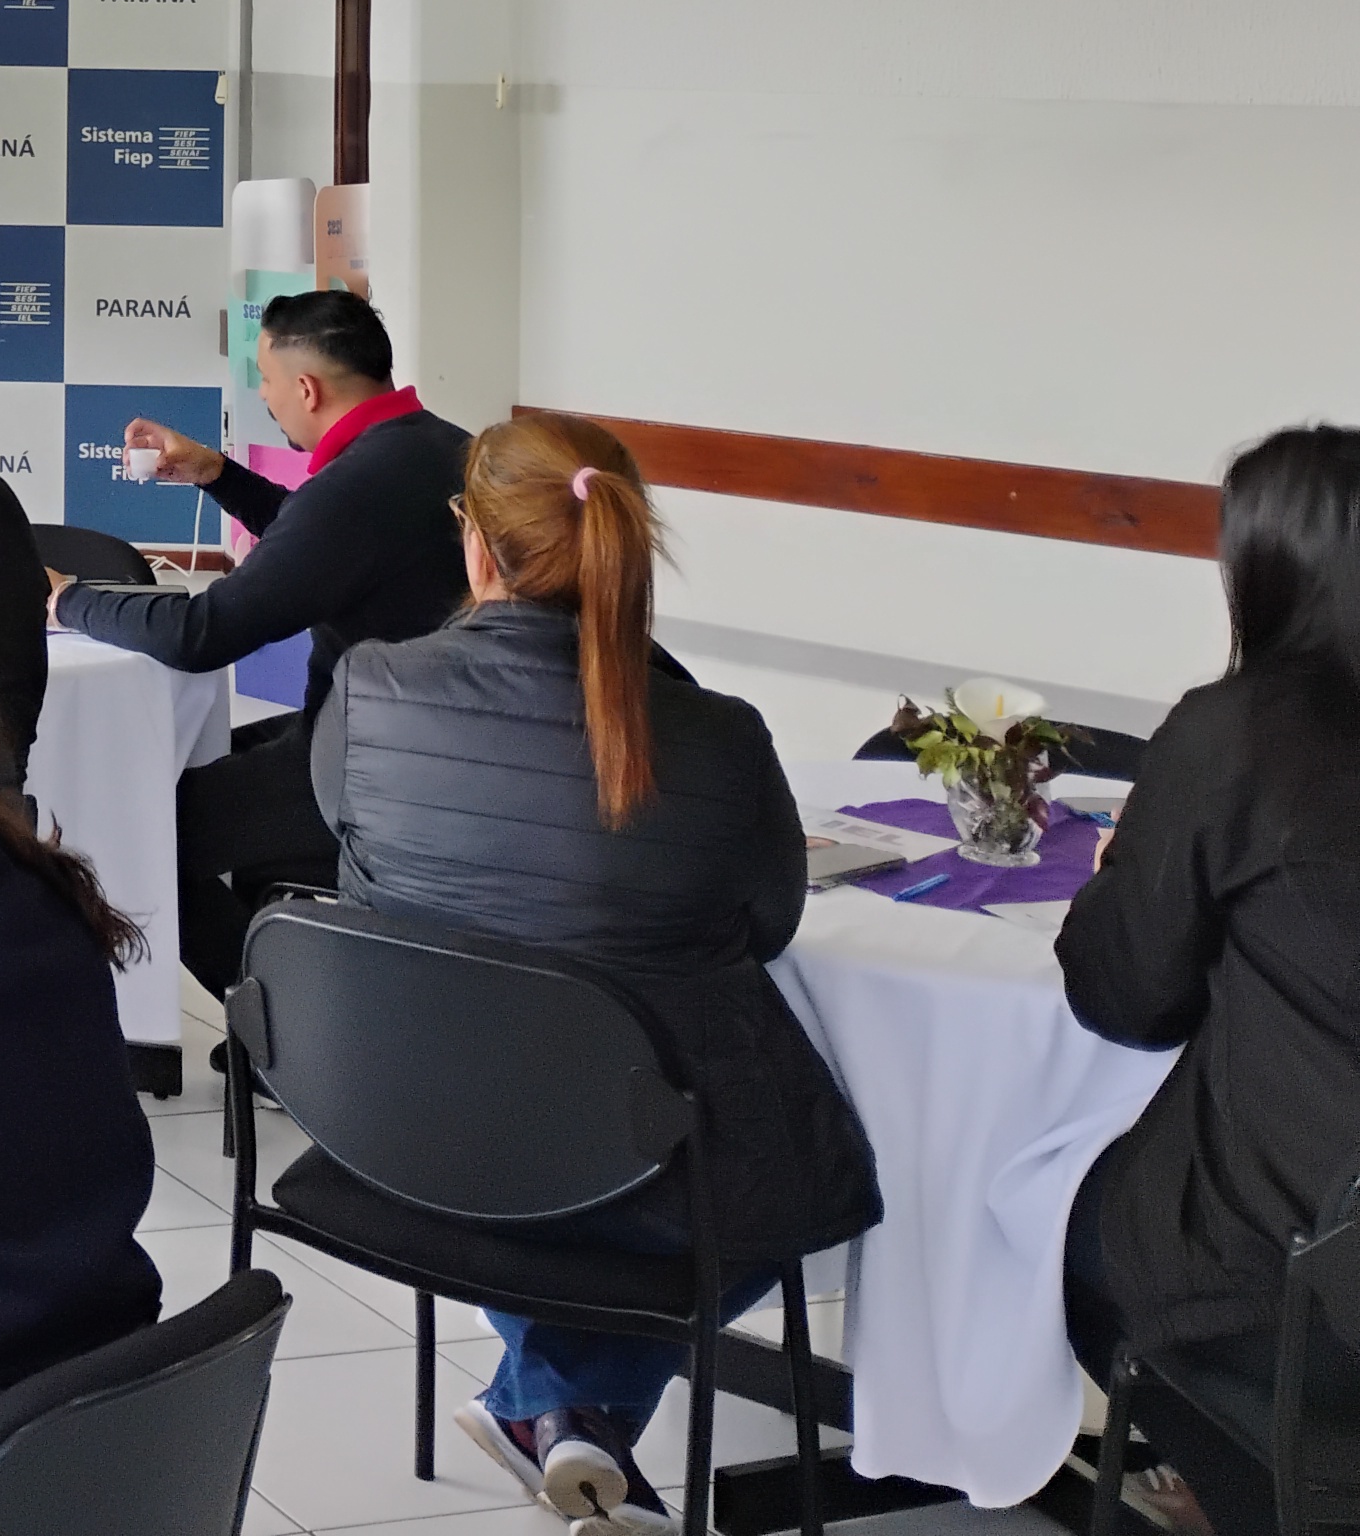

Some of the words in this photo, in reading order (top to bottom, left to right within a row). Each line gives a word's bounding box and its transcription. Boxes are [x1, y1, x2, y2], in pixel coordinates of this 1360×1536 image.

[82, 127, 153, 143] Sistema
[115, 149, 153, 168] Fiep
[97, 296, 191, 318] PARANÁ
